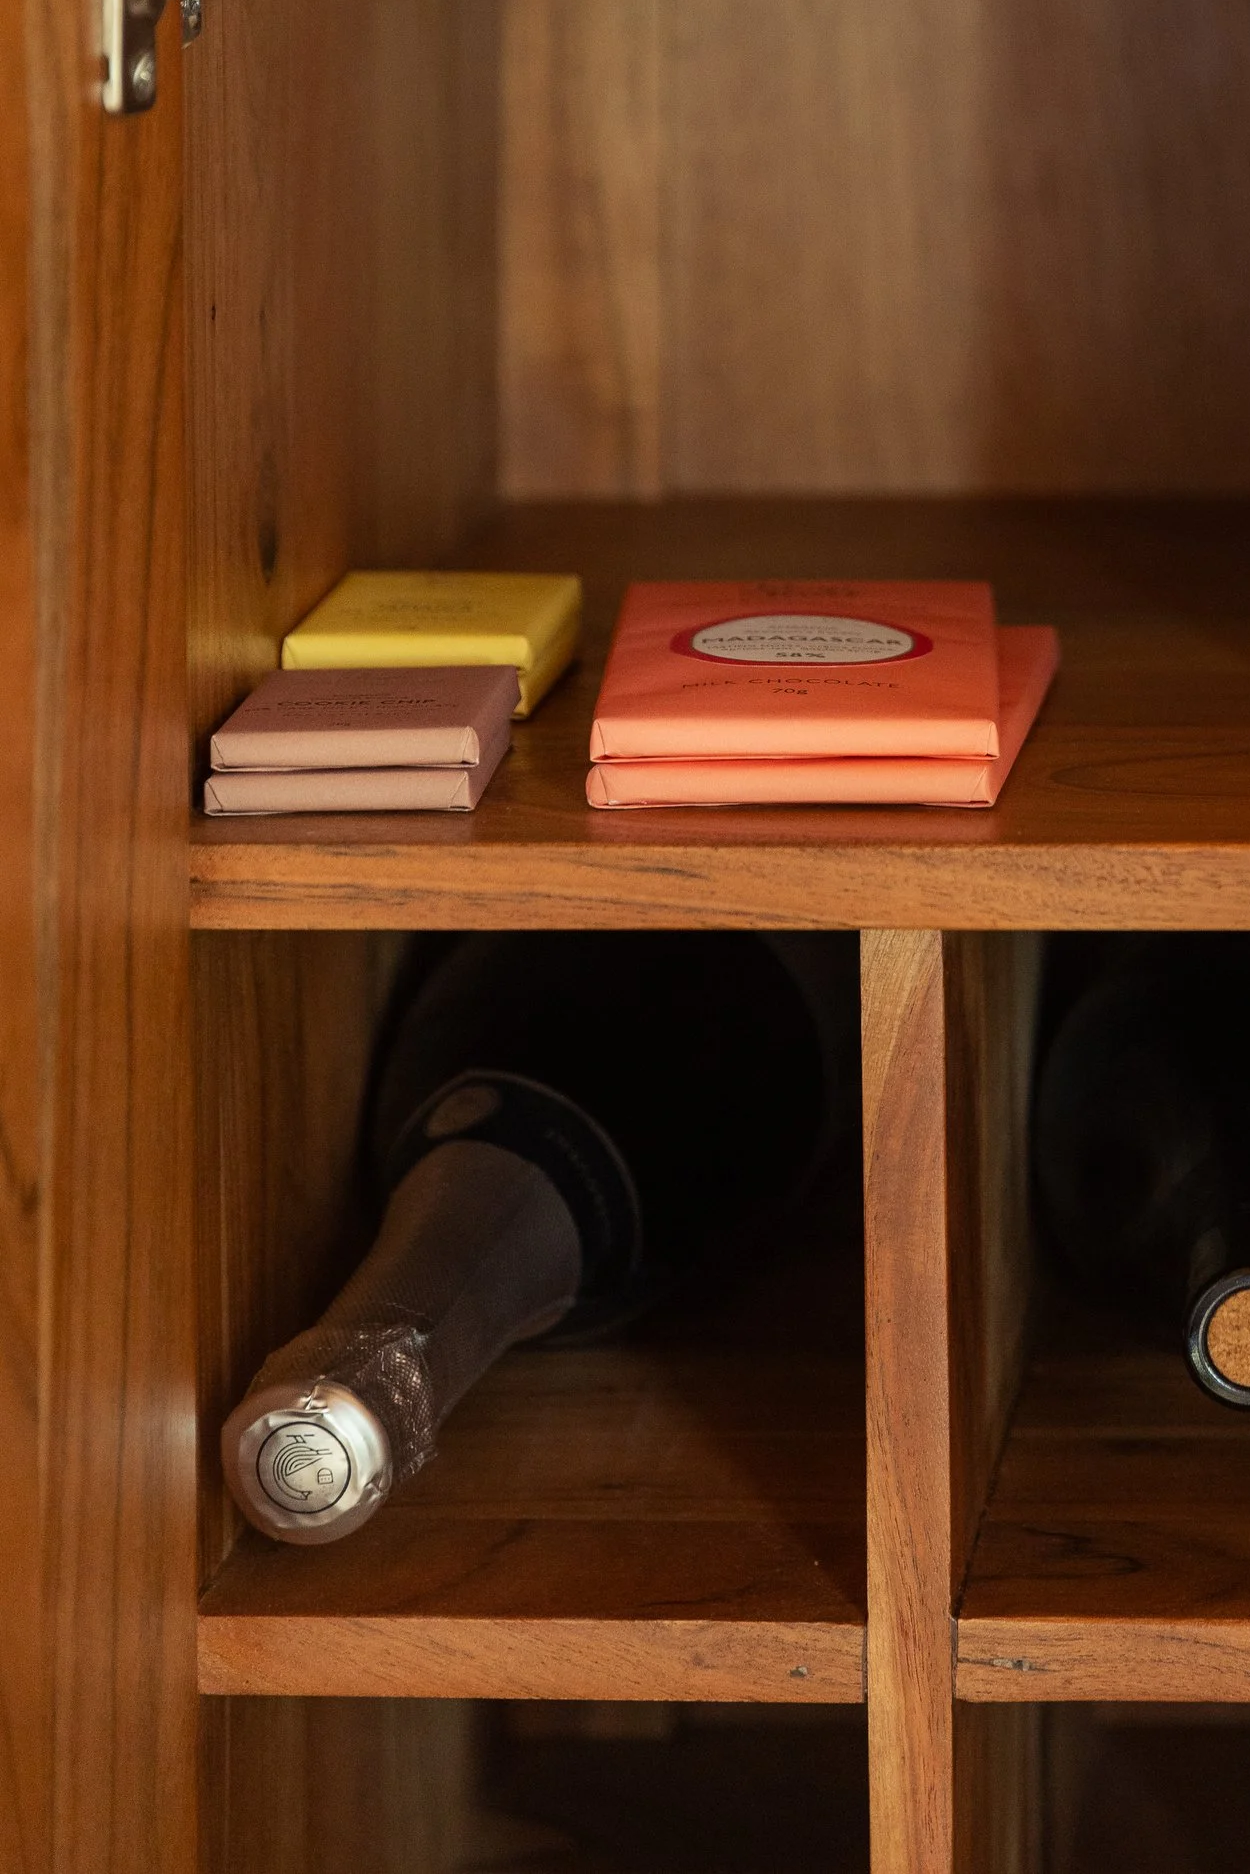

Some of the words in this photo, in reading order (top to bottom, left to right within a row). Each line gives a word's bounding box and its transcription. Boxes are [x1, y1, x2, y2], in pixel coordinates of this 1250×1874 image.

[702, 635, 902, 645] MADAGASCAR
[682, 680, 737, 689] MILK
[748, 678, 900, 689] CHOCOLATE
